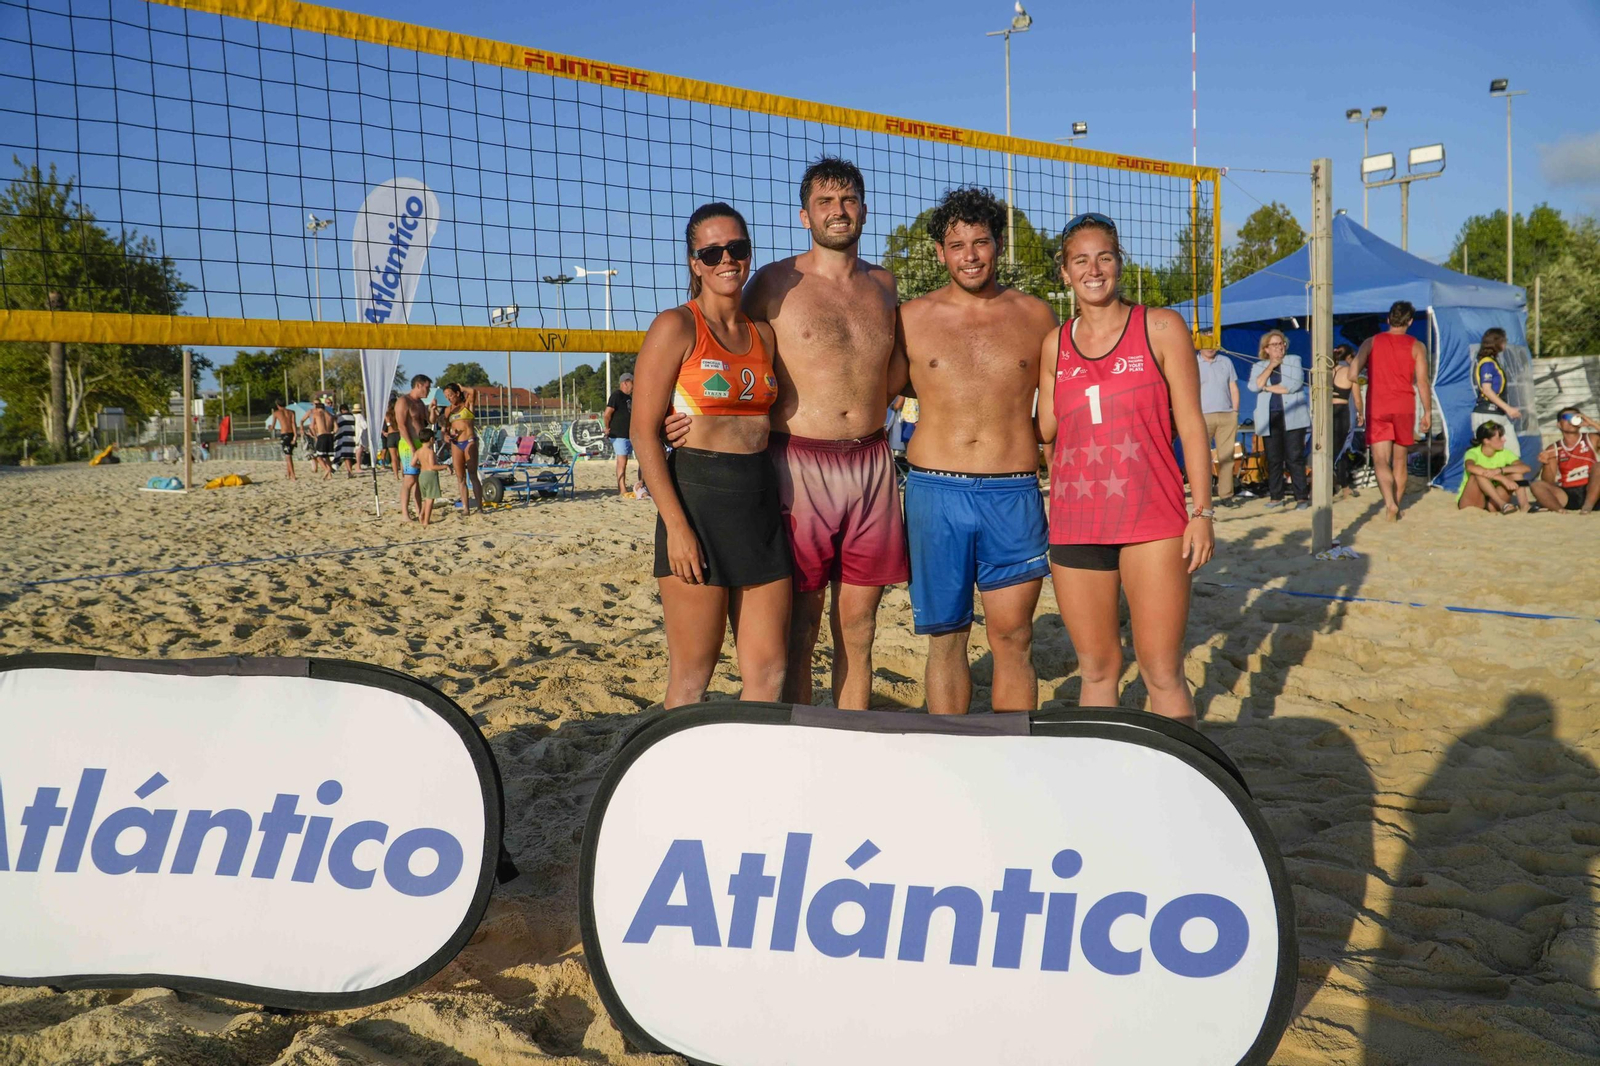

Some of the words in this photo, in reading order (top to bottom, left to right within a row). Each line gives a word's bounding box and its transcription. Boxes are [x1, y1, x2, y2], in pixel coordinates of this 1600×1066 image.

[524, 51, 650, 88] FUNTEC
[886, 118, 964, 142] FUNTEC
[1117, 157, 1170, 174] FUNTEC
[364, 195, 423, 324] Atlántico
[738, 367, 756, 402] 2
[1085, 384, 1103, 425] 1
[0, 767, 465, 898] tlántico
[622, 831, 1250, 979] Atlántico
